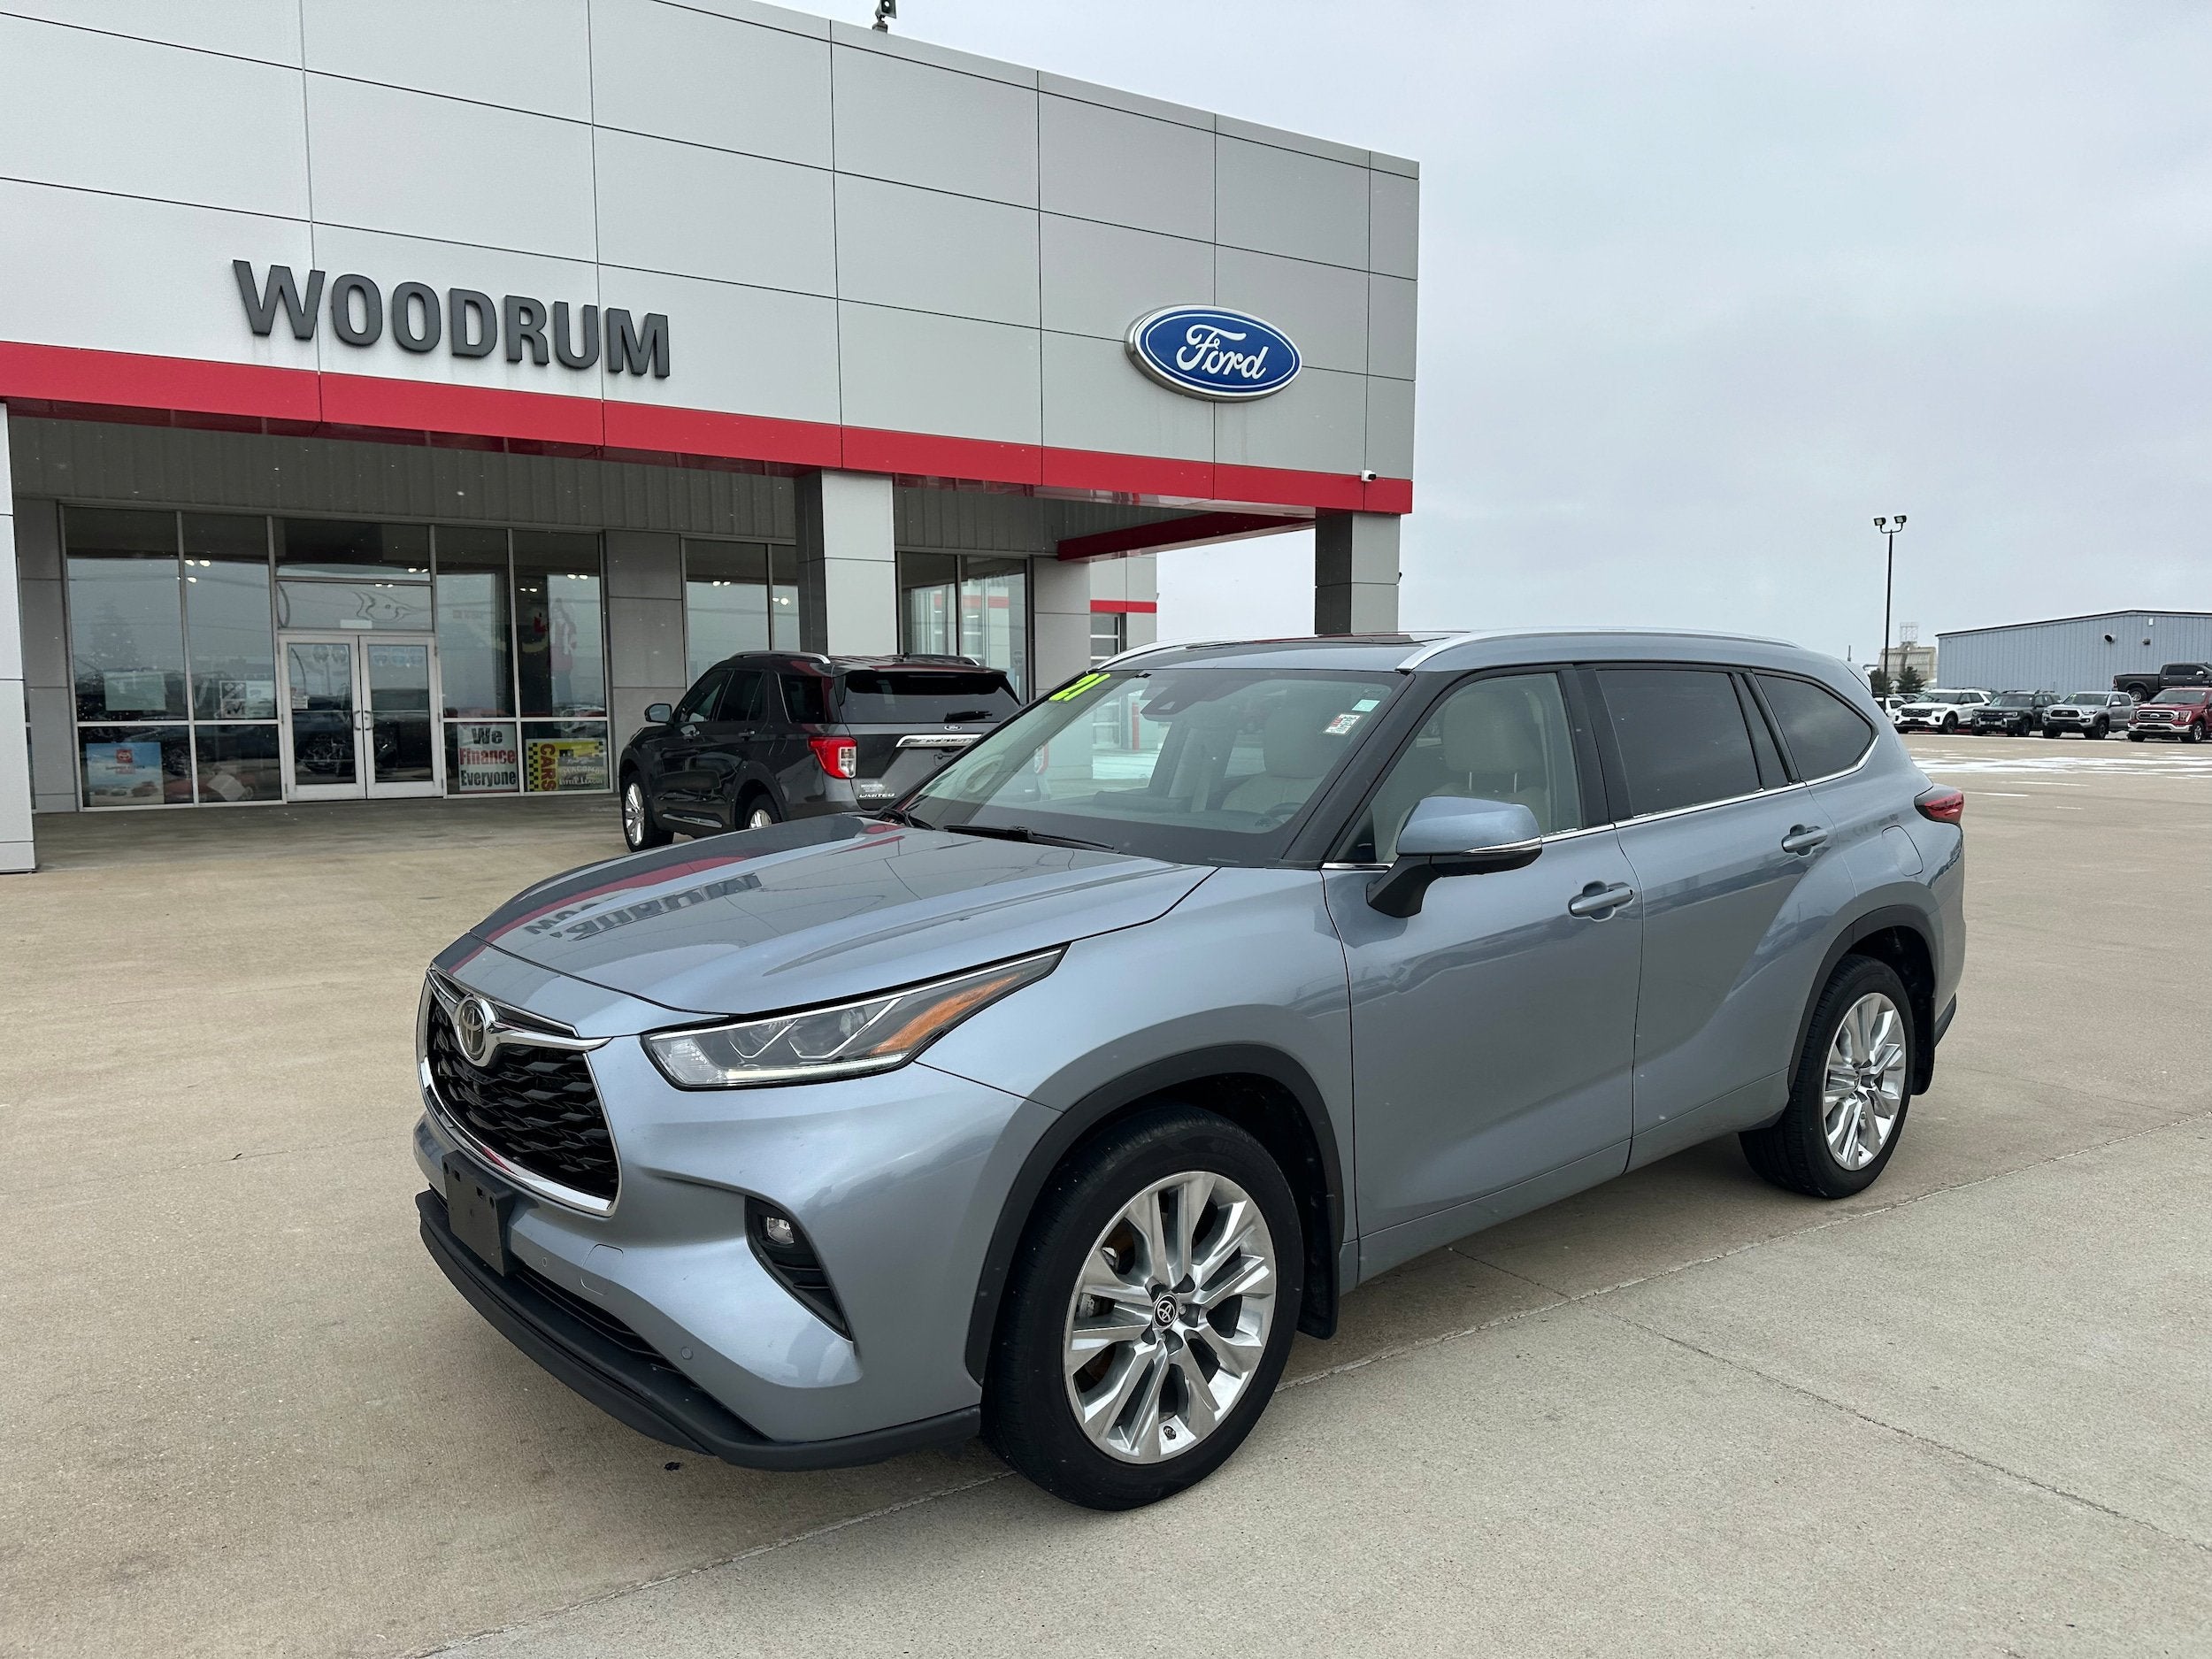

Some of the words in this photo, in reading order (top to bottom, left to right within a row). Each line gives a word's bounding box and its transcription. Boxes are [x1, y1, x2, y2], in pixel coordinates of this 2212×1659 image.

[233, 259, 671, 379] WOODRUM
[1176, 324, 1270, 380] Ford
[471, 727, 503, 745] We
[459, 747, 517, 765] Finance
[540, 743, 557, 791] CARS
[460, 769, 517, 787] Everyone
